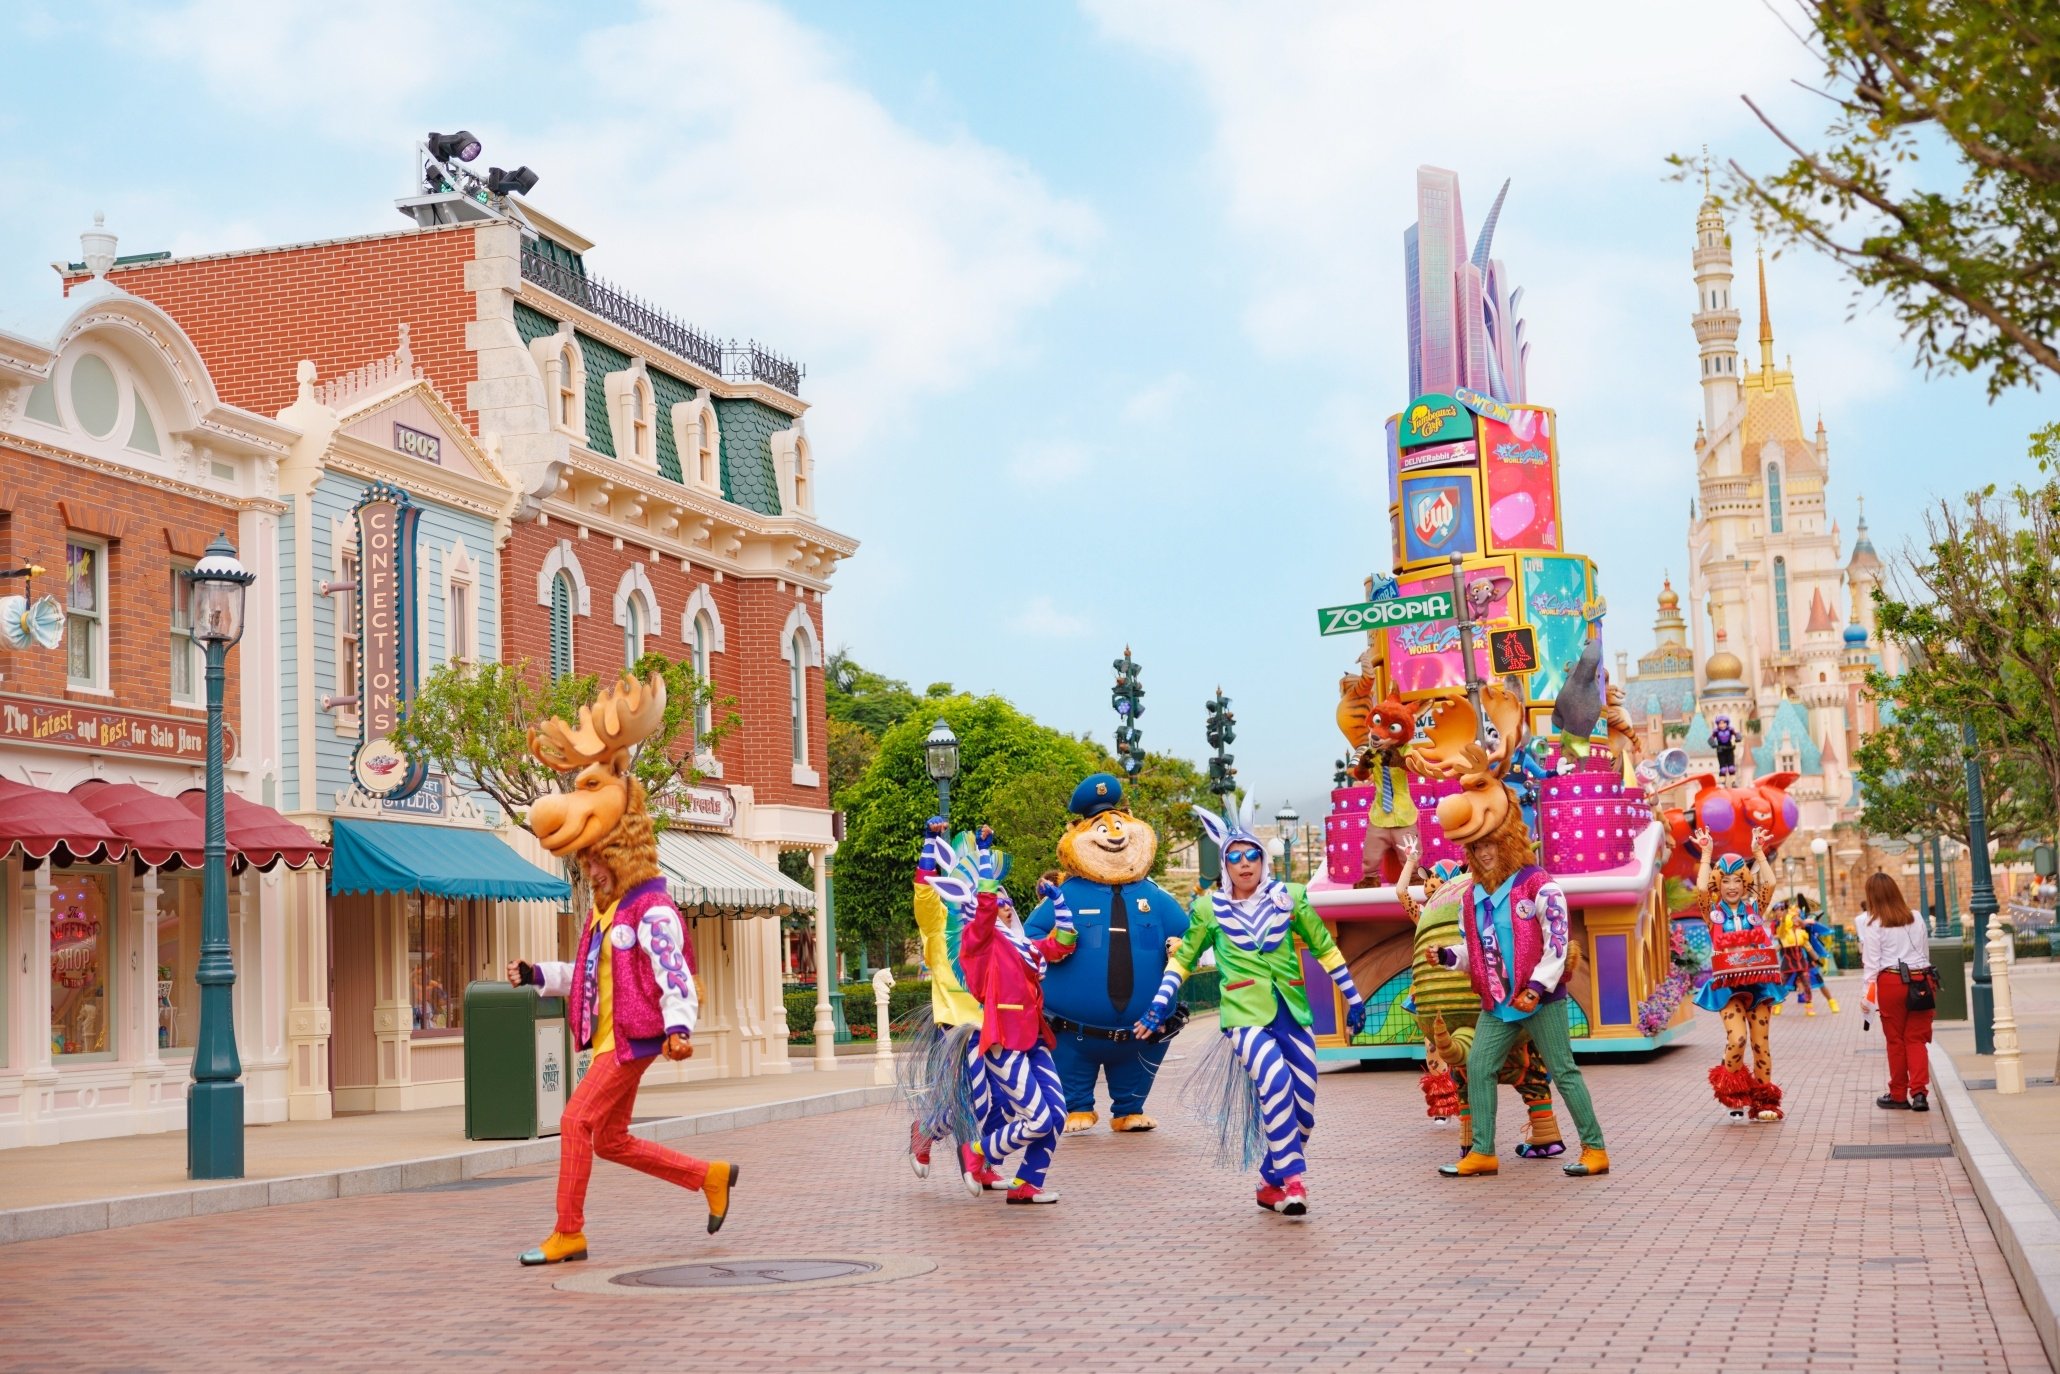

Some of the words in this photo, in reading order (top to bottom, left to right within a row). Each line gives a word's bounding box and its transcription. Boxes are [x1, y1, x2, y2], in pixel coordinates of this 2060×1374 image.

[398, 429, 438, 460] 1902
[1404, 452, 1450, 467] DELIVERabbit
[370, 513, 390, 730] CONFECTIONS
[1323, 596, 1450, 635] ZOOTOPIA
[1409, 643, 1440, 655] WORLD
[1456, 640, 1484, 651] TUR
[4, 705, 28, 734] The
[33, 711, 73, 738] Latest
[78, 718, 97, 743] and
[101, 718, 128, 746] Best
[131, 722, 147, 745] for
[151, 724, 174, 748] Sale
[178, 728, 202, 754] Here
[1539, 889, 1568, 958] TOUR
[58, 949, 90, 970] SHOP
[642, 914, 689, 999] TOUR
[542, 1071, 559, 1085] STREET
[544, 1063, 557, 1072] MAIN
